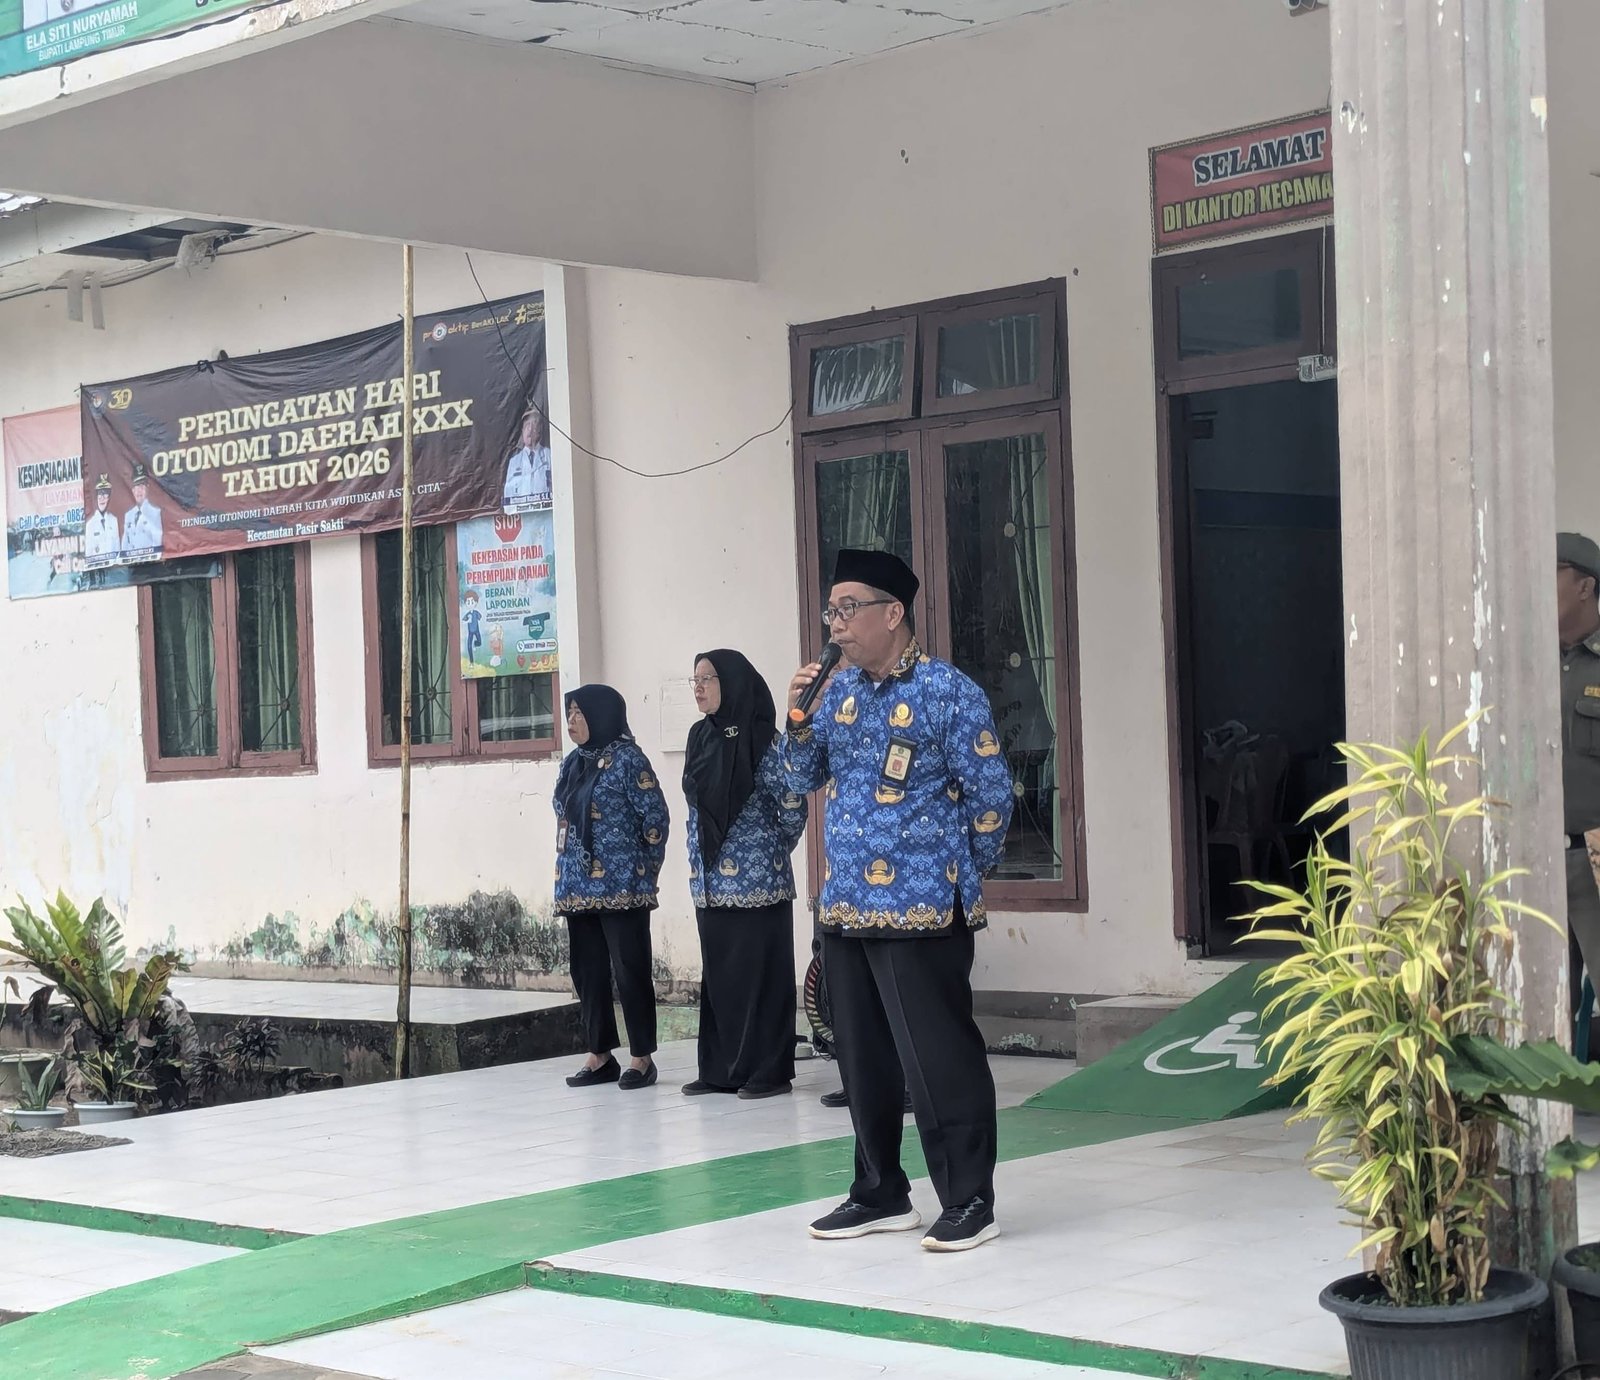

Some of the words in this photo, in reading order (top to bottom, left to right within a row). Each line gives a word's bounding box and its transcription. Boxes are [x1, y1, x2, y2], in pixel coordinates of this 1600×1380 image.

[26, 33, 46, 50] ELA
[48, 23, 70, 42] SITI
[73, 1, 138, 34] NURYAMAH
[39, 44, 63, 60] BUPATI
[64, 33, 100, 52] LAMPUNG
[102, 25, 126, 41] TIMUR
[1192, 128, 1326, 187] SELAMAT
[1163, 202, 1182, 233] DI
[1185, 188, 1255, 228] KANTOR
[178, 386, 357, 442] PERINGATAN
[364, 370, 441, 410] HARI
[152, 434, 272, 477] OTONOMI
[278, 411, 403, 458] DAERAH
[412, 399, 473, 435] XXX
[17, 457, 79, 489] KESIAPSIAGAAN
[222, 459, 320, 497] TAHUN
[327, 447, 390, 482] 2026
[34, 514, 60, 527] Center
[220, 509, 262, 523] OTONOMI
[263, 502, 302, 517] DAERAH
[305, 499, 328, 511] KITA
[330, 491, 385, 506] WUJUDKAN
[495, 513, 520, 531] STOP
[246, 526, 294, 542] Kecamatan
[295, 521, 319, 536] Pasir
[320, 517, 344, 533] Sakti
[471, 547, 519, 566] KEKERASAN
[520, 545, 543, 561] PADA
[466, 567, 516, 584] PEREMPUAN
[526, 564, 549, 580] ANAK
[485, 586, 515, 598] BERANI
[485, 597, 530, 610] LAPORKAN
